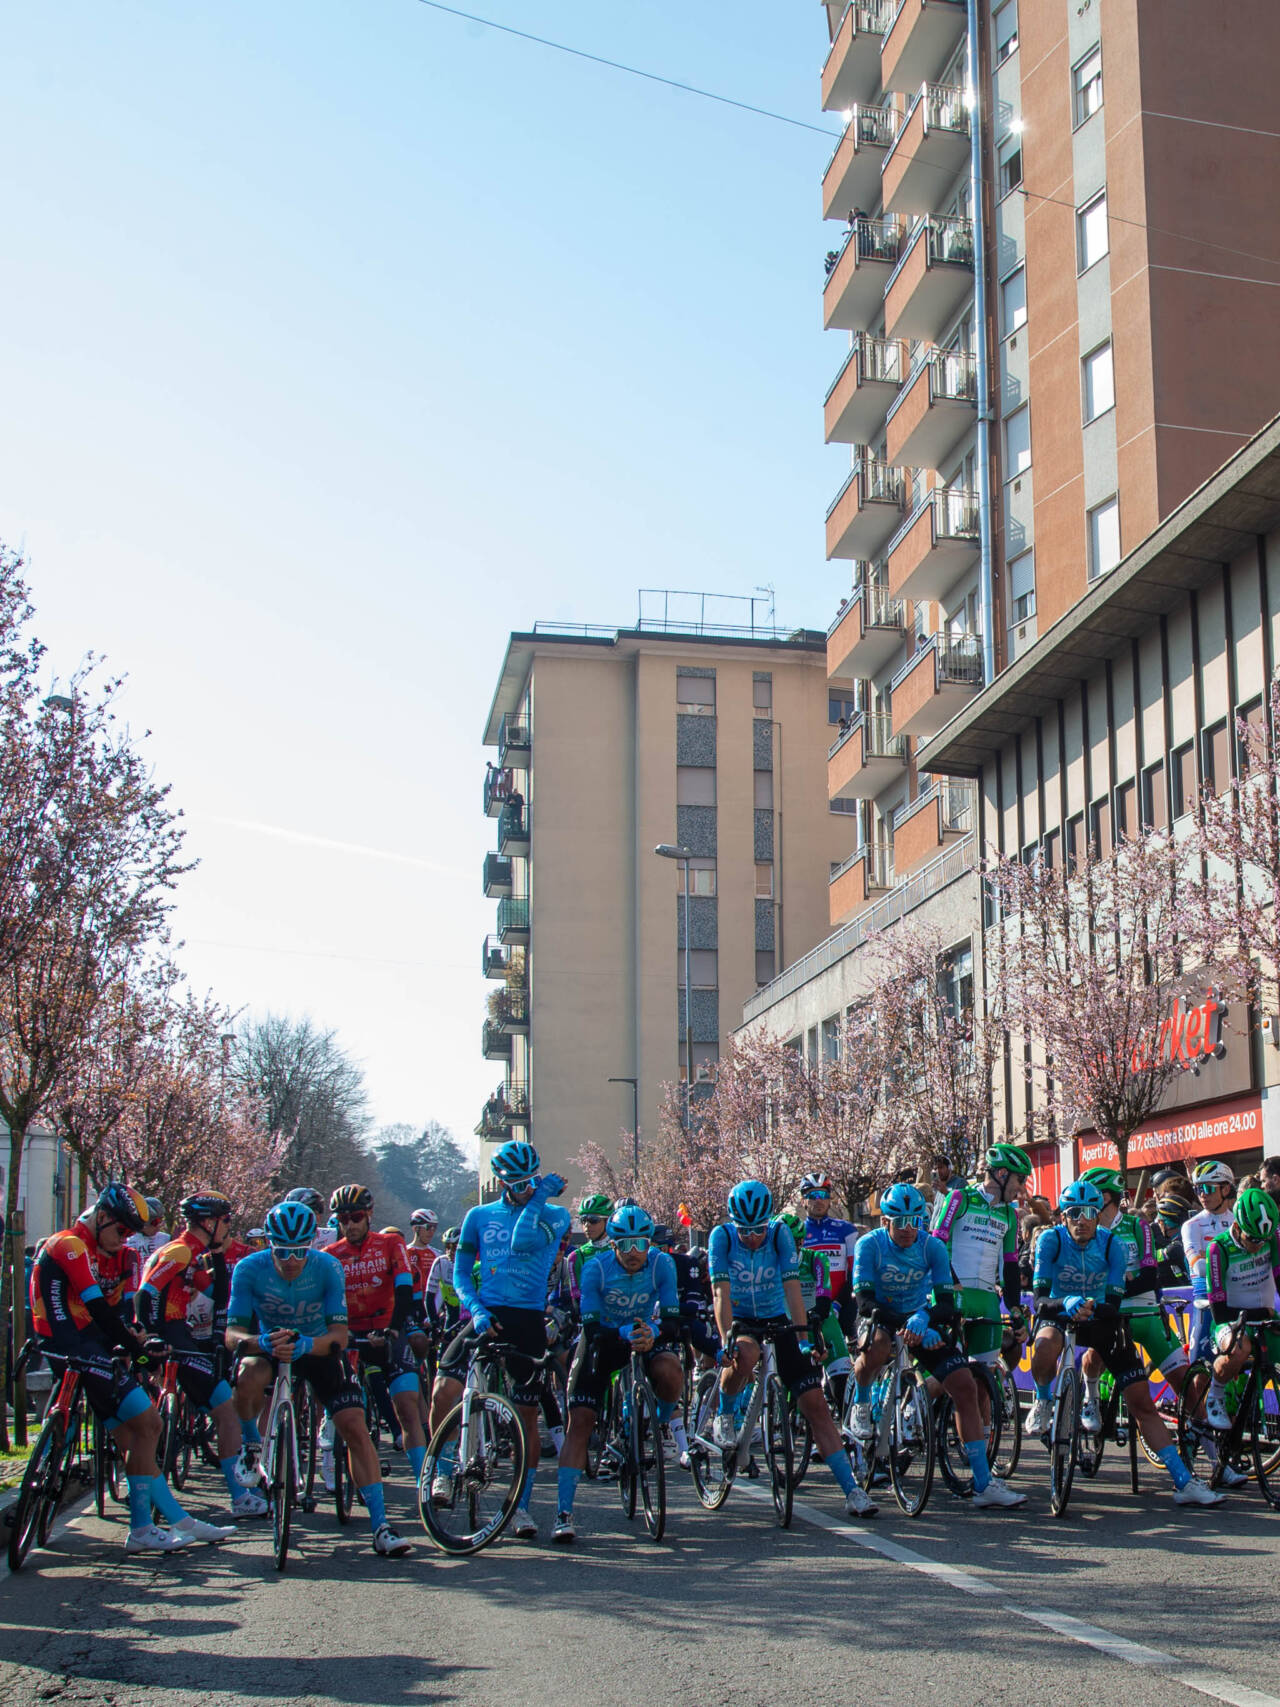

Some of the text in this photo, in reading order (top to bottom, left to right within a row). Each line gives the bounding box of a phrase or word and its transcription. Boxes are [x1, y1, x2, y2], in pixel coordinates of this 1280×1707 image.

[1081, 1143, 1103, 1164] Aperti
[1103, 1143, 1108, 1158] 7
[1144, 1131, 1163, 1149] dalle
[1164, 1131, 1177, 1145] ore
[1178, 1125, 1197, 1143] 8.00
[1198, 1123, 1213, 1140] alle
[1214, 1122, 1228, 1136] ore
[1229, 1112, 1257, 1132] 24.00
[483, 1228, 510, 1243] eo
[343, 1257, 387, 1272] AHRAIN
[881, 1267, 925, 1283] eolo
[50, 1279, 67, 1321] BAHRAIN
[187, 1312, 208, 1323] AE
